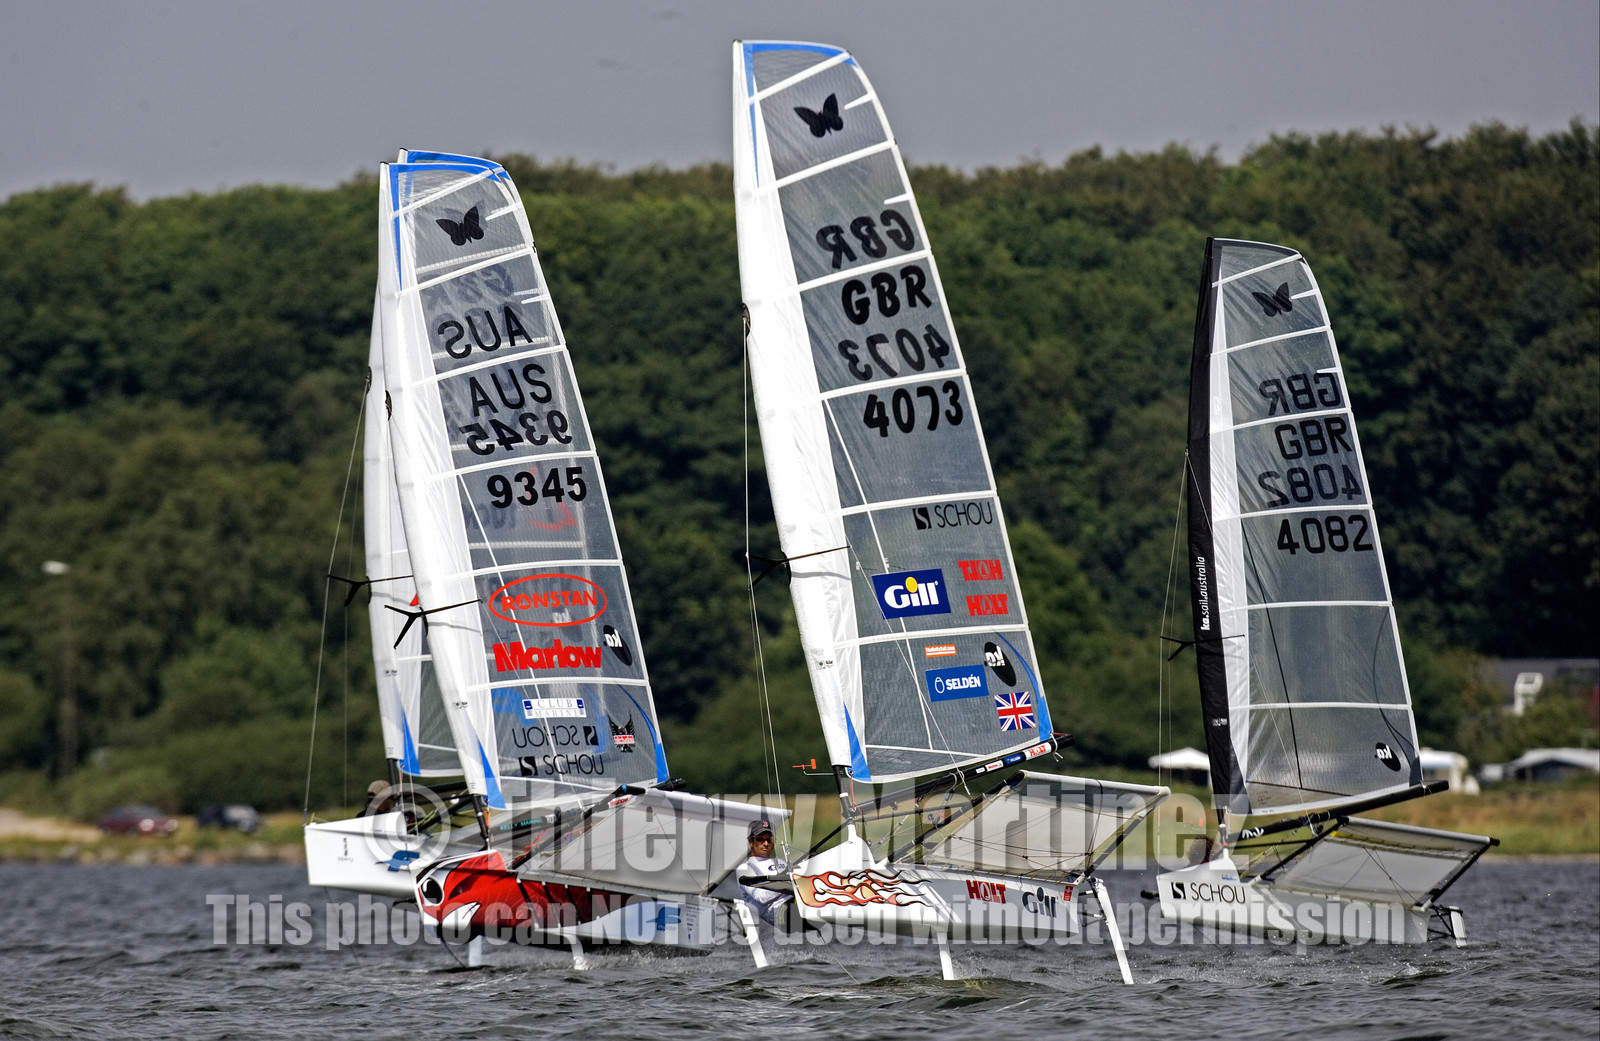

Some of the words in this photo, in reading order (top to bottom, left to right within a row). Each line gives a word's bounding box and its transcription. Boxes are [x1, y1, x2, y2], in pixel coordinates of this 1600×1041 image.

[841, 265, 932, 325] GBR
[468, 364, 552, 416] AUS
[863, 380, 964, 438] 4073
[1274, 416, 1353, 460] GBR
[486, 466, 587, 508] 9345
[934, 501, 993, 529] SCHOU
[1277, 514, 1374, 555] 4082
[501, 590, 598, 612] RONSTAN
[884, 576, 940, 609] Gill
[965, 593, 1009, 617] HOLT
[492, 638, 602, 673] Marlow
[946, 674, 982, 691] SELDÉN
[537, 698, 574, 709] CLUB
[542, 753, 605, 776] SCHOU
[966, 879, 1006, 904] HOLT
[1022, 886, 1057, 918] Gill
[1190, 882, 1246, 904] SCHOU
